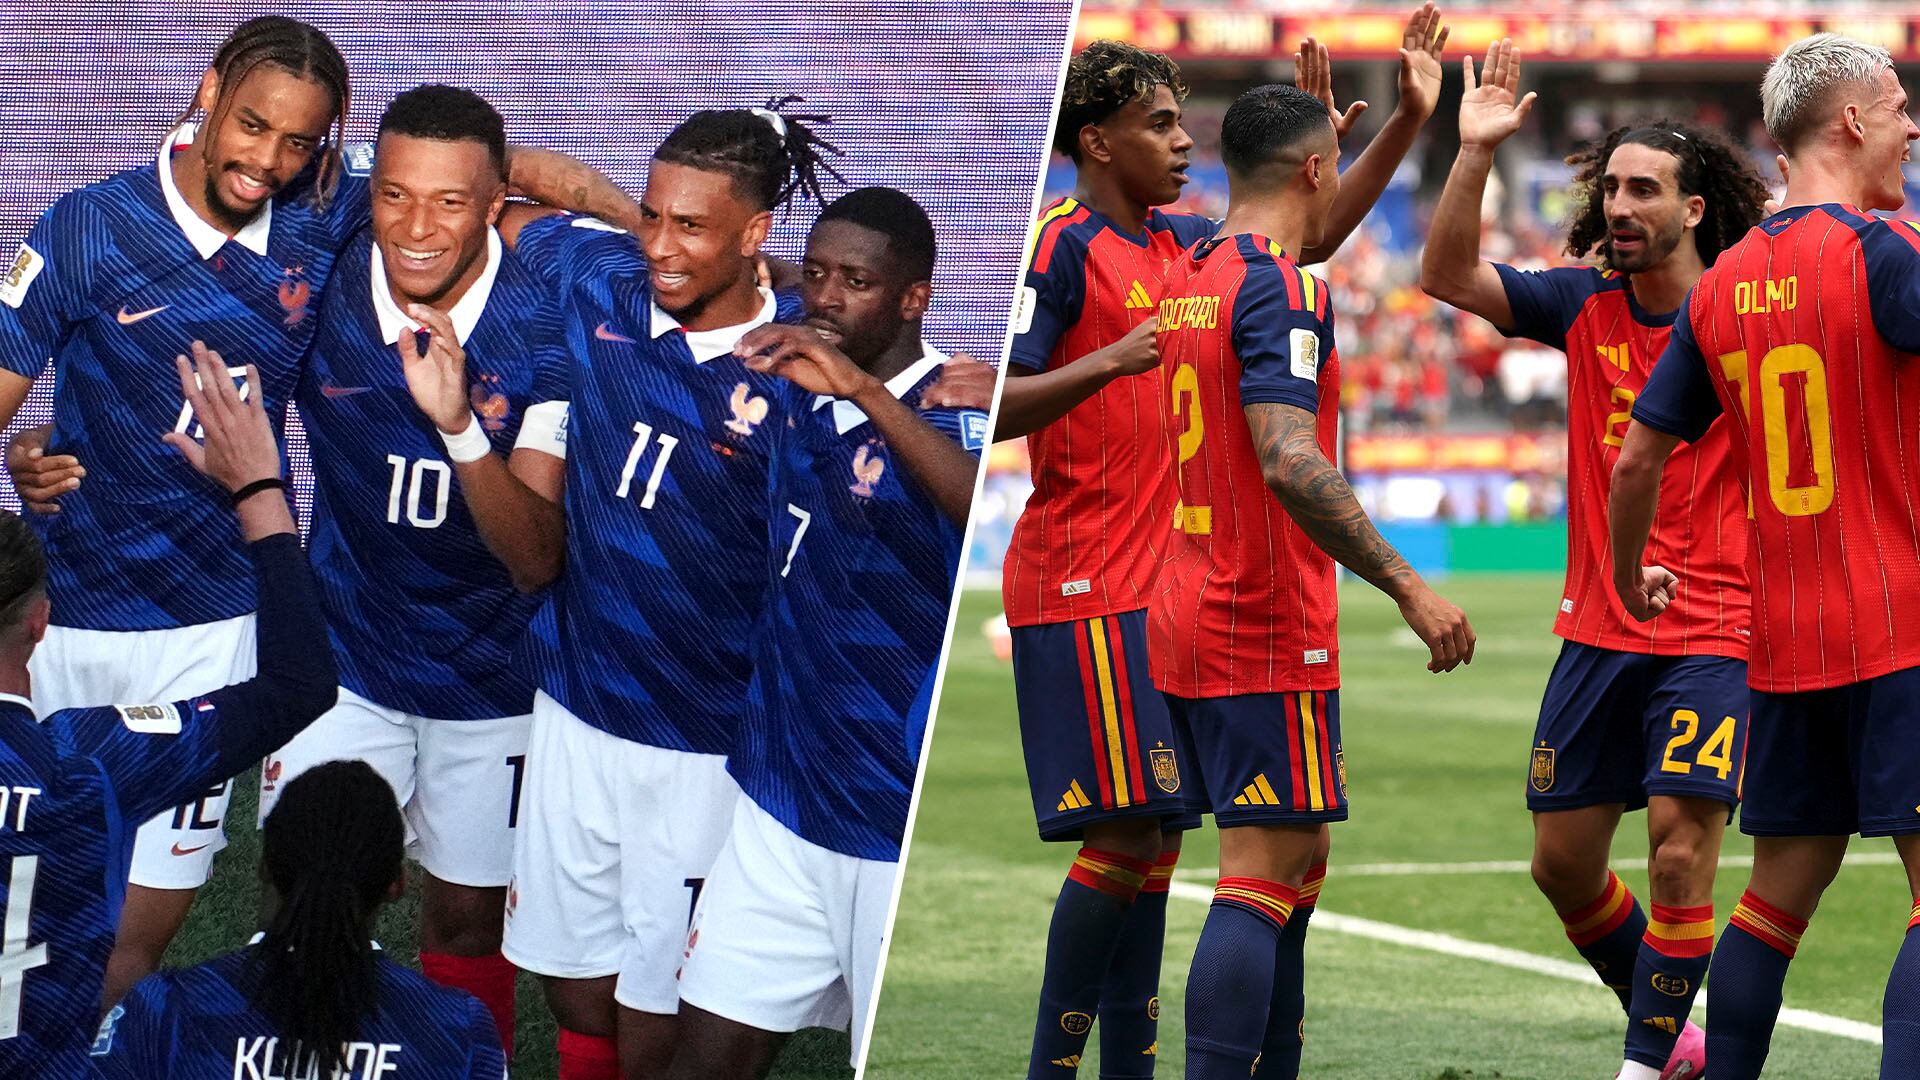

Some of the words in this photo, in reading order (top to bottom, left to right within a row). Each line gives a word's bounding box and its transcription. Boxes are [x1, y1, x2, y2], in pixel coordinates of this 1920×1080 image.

[1734, 275, 1798, 315] OLMO
[387, 454, 451, 529] 10
[616, 421, 679, 510] 11
[781, 502, 811, 578] 7
[1661, 709, 1736, 781] 24
